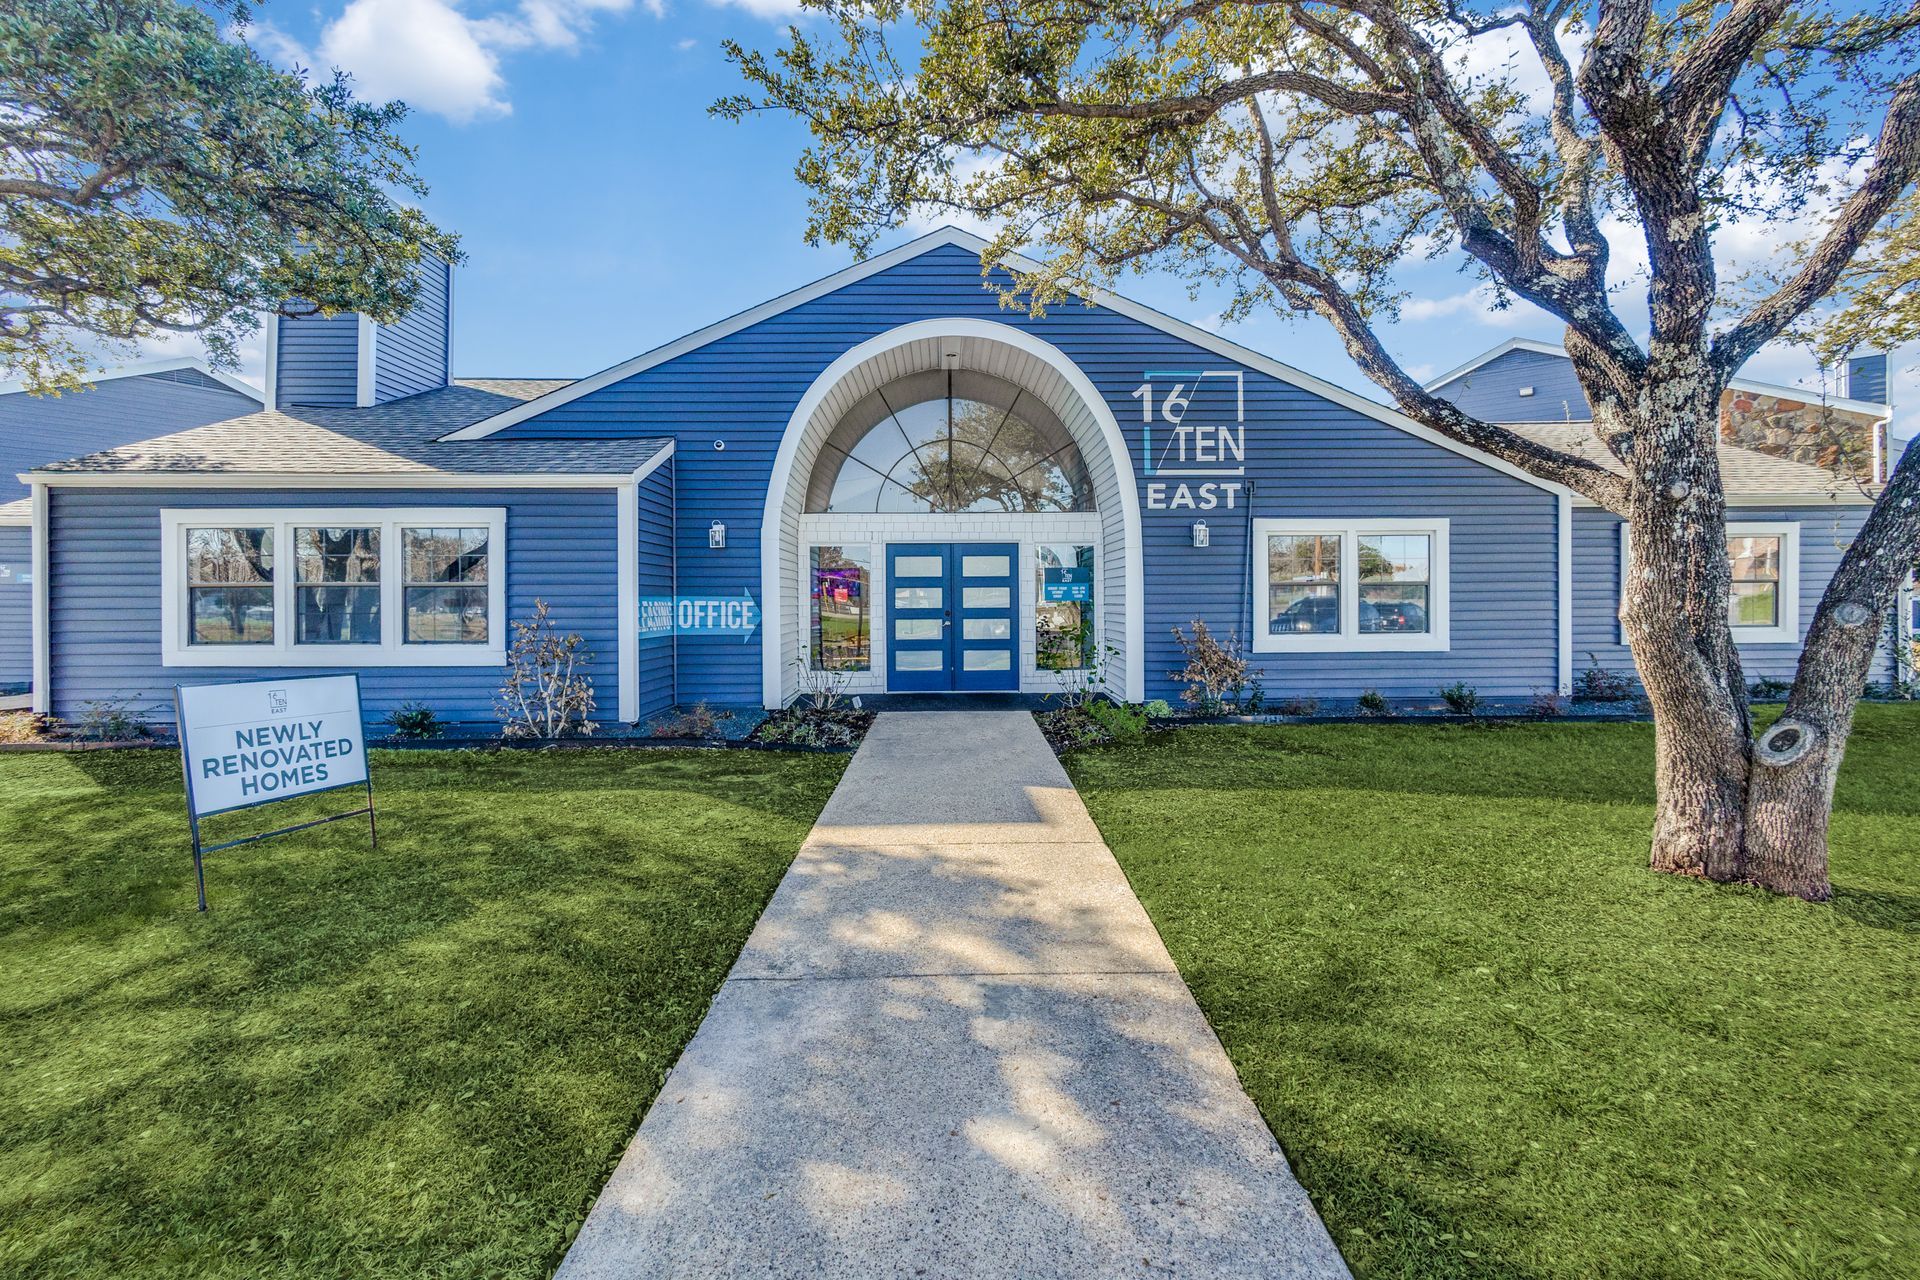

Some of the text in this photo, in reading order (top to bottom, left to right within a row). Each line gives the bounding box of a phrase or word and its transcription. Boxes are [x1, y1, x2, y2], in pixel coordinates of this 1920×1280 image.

[1131, 383, 1189, 424] 16
[1176, 426, 1245, 462] TEN
[1147, 483, 1242, 510] EAST
[678, 600, 756, 629] OFFICE
[275, 698, 288, 706] TEN
[235, 720, 323, 749] NEWLY
[202, 738, 353, 779] RENOVATED
[240, 763, 329, 796] HOMES
